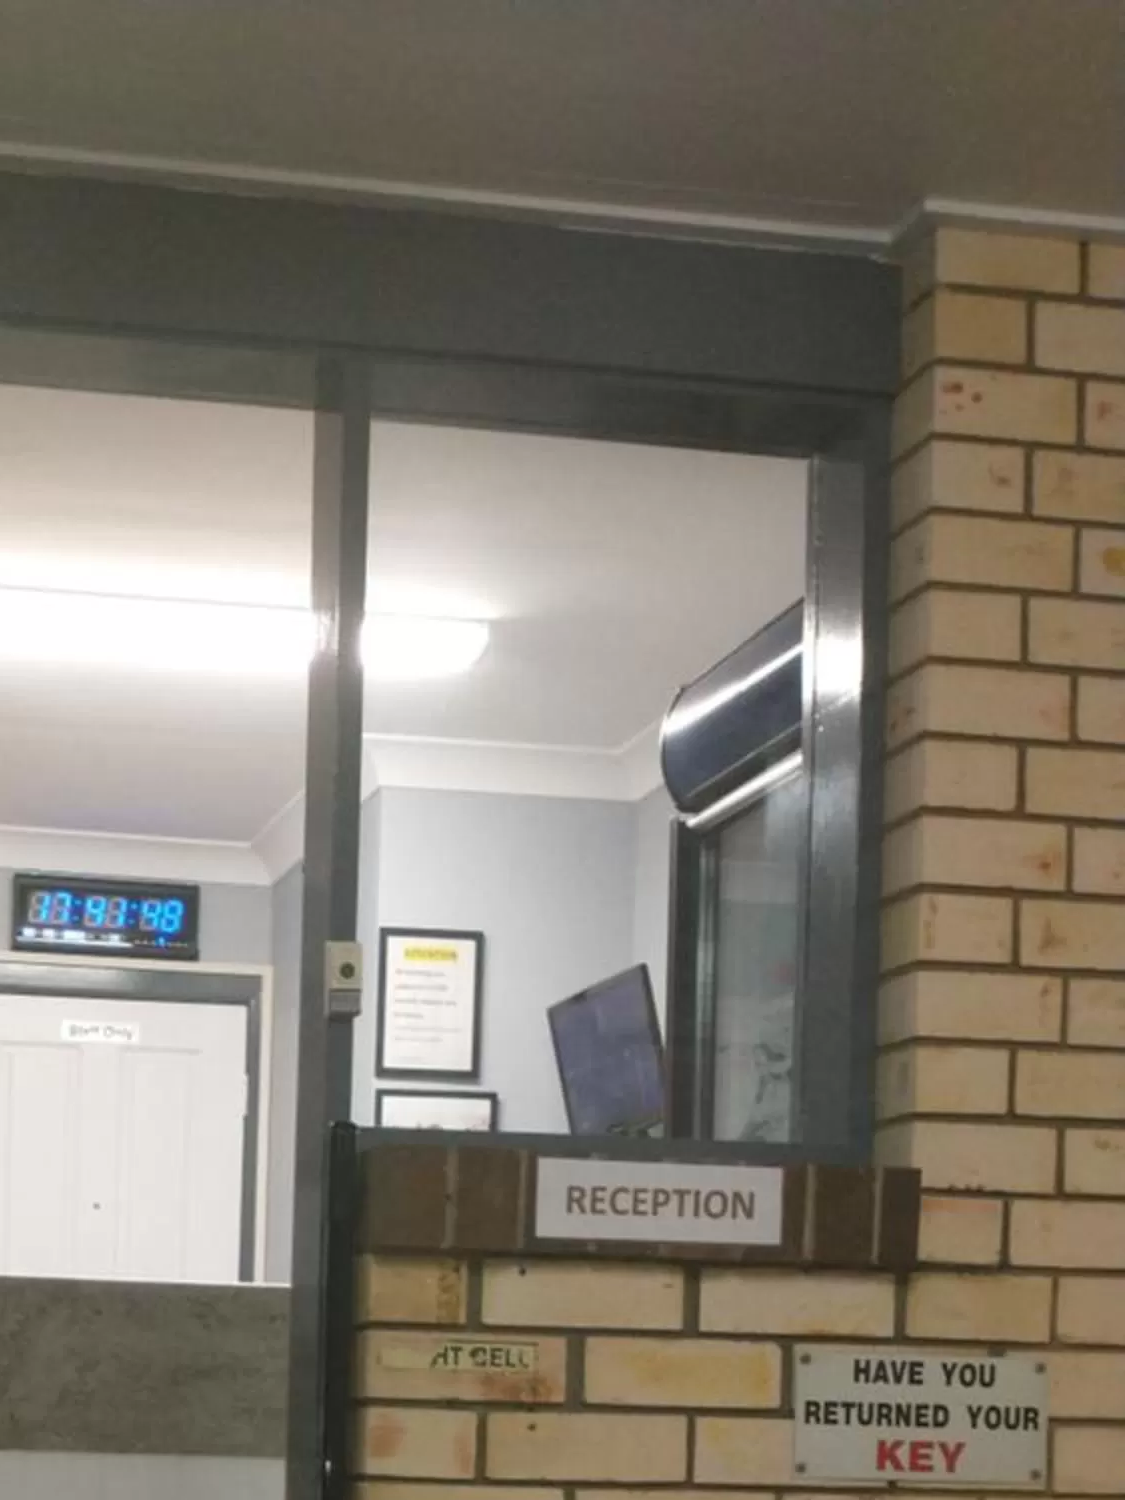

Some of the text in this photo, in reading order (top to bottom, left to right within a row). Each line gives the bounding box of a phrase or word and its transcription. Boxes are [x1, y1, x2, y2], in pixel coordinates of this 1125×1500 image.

[565, 1185, 756, 1220] RECEPTION
[853, 1359, 996, 1388] HAVE YOU
[804, 1400, 1040, 1431] RETURNED YOUR
[876, 1439, 967, 1474] KEY
